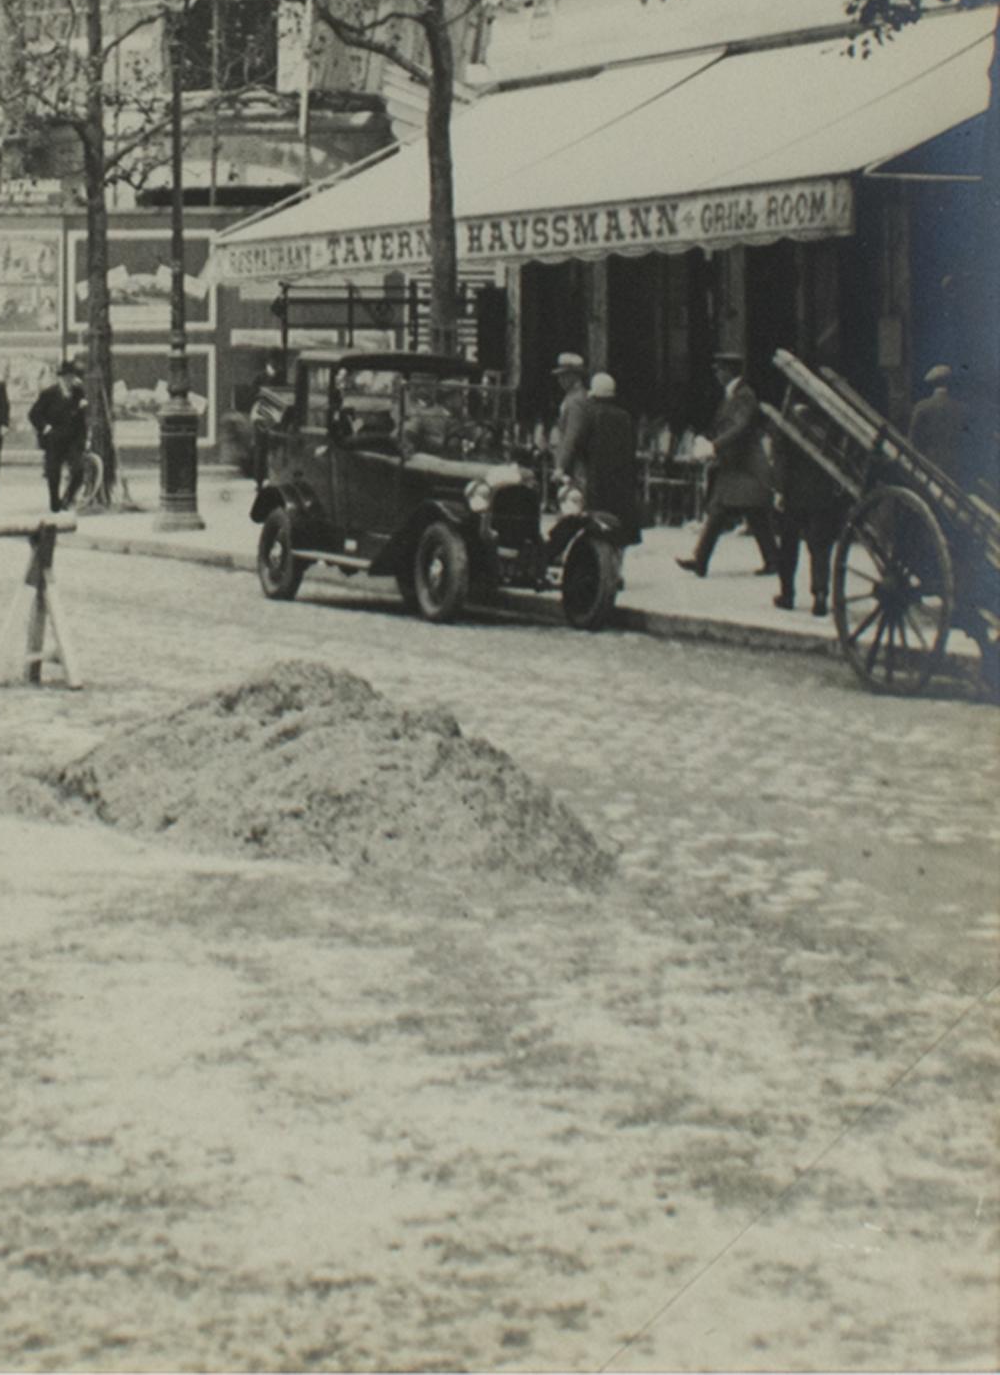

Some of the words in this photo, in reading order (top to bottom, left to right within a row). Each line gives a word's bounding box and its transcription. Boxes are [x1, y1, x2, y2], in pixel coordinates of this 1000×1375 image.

[327, 228, 434, 266] TAVERN
[466, 202, 680, 253] HAUSSMANN
[701, 197, 758, 234] GRILL
[766, 190, 828, 227] ROOM
